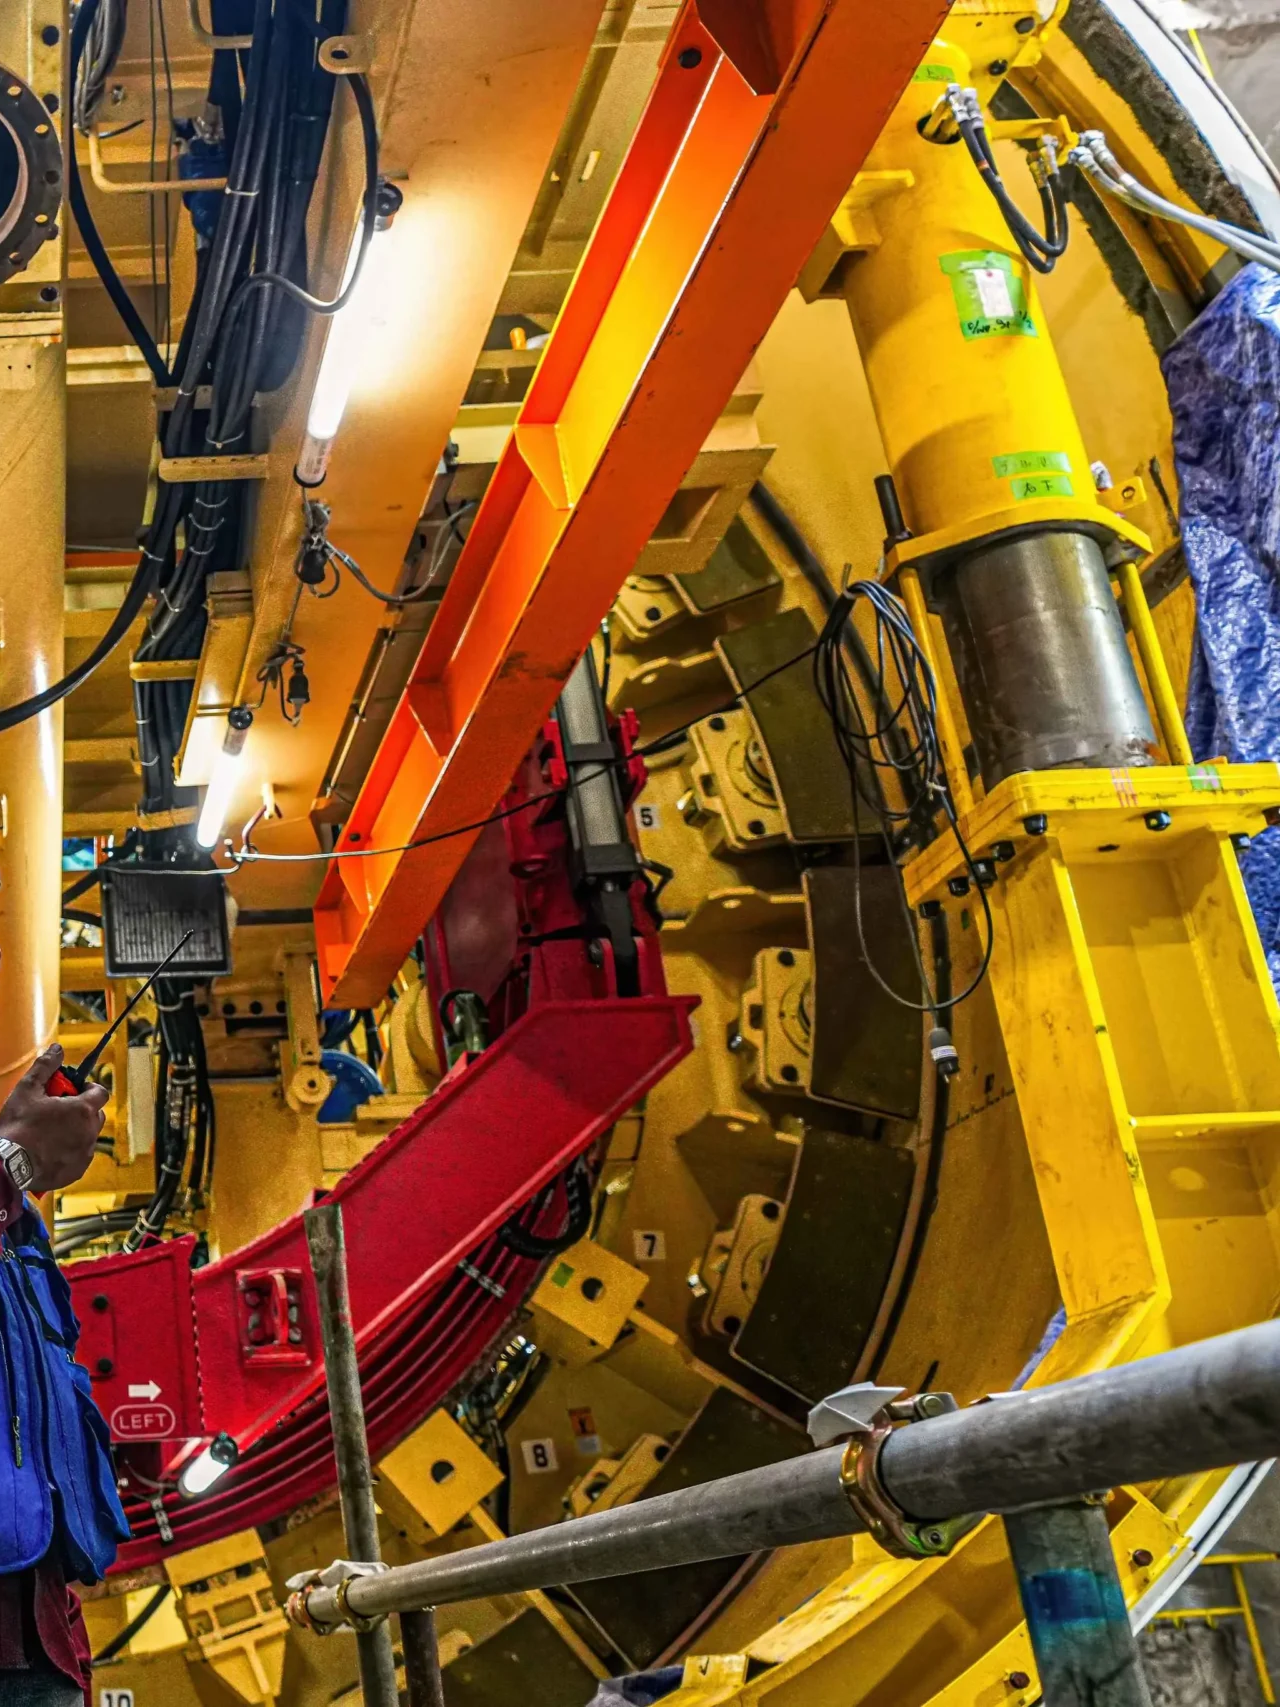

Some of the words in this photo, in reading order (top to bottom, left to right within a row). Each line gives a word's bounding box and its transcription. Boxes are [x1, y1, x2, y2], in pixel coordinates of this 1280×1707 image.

[640, 807, 653, 827] 5
[642, 1234, 657, 1257] 7
[120, 1413, 166, 1429] LEFT
[532, 1444, 548, 1467] 8
